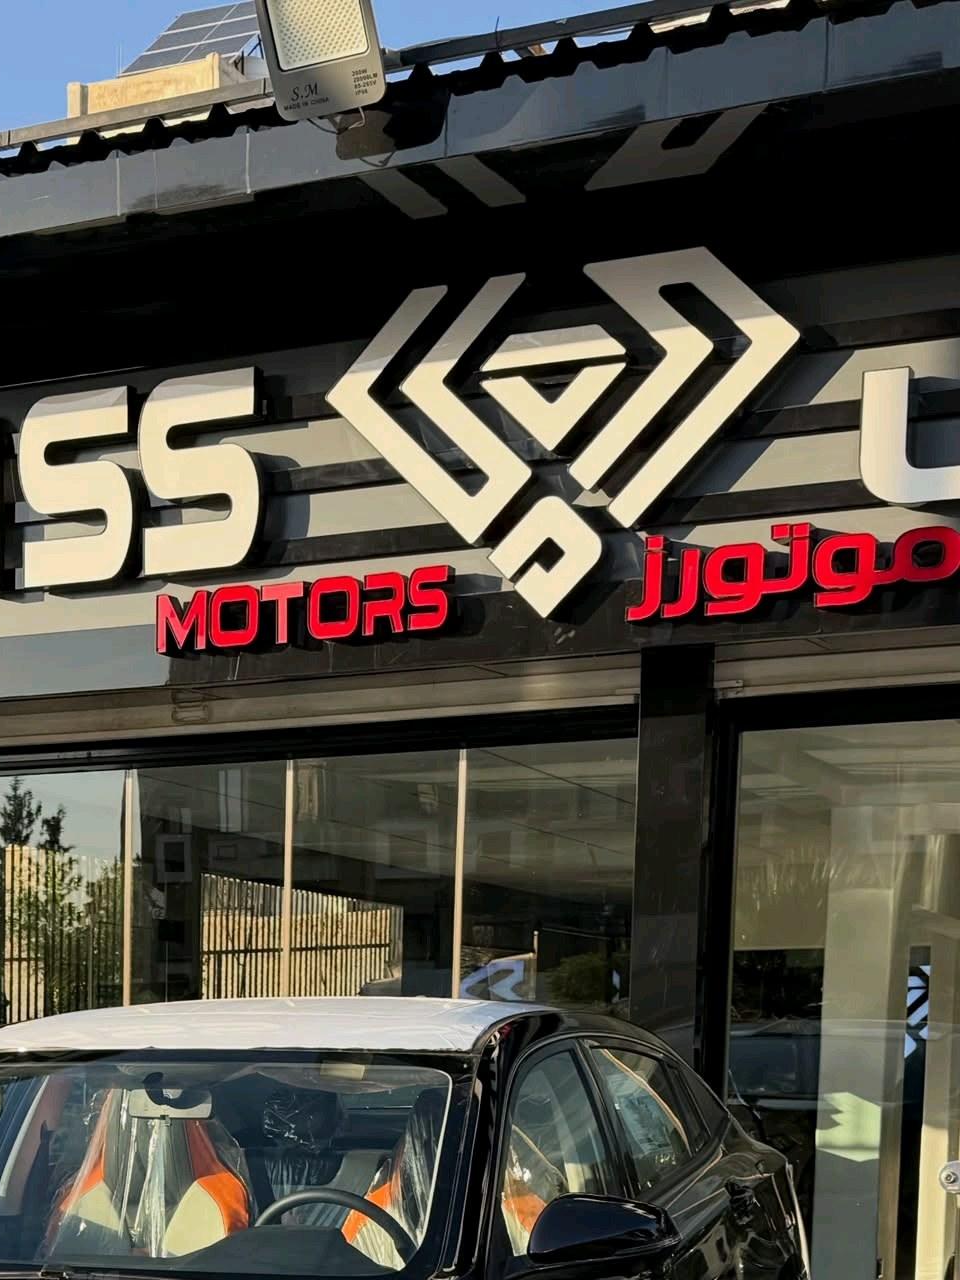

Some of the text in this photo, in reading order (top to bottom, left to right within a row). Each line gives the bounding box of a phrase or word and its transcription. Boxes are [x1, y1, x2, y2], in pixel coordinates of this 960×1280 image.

[283, 102, 301, 111] MADE
[291, 82, 319, 101] S.M
[625, 521, 960, 622] موتورز
[155, 564, 453, 656] MOTORS
